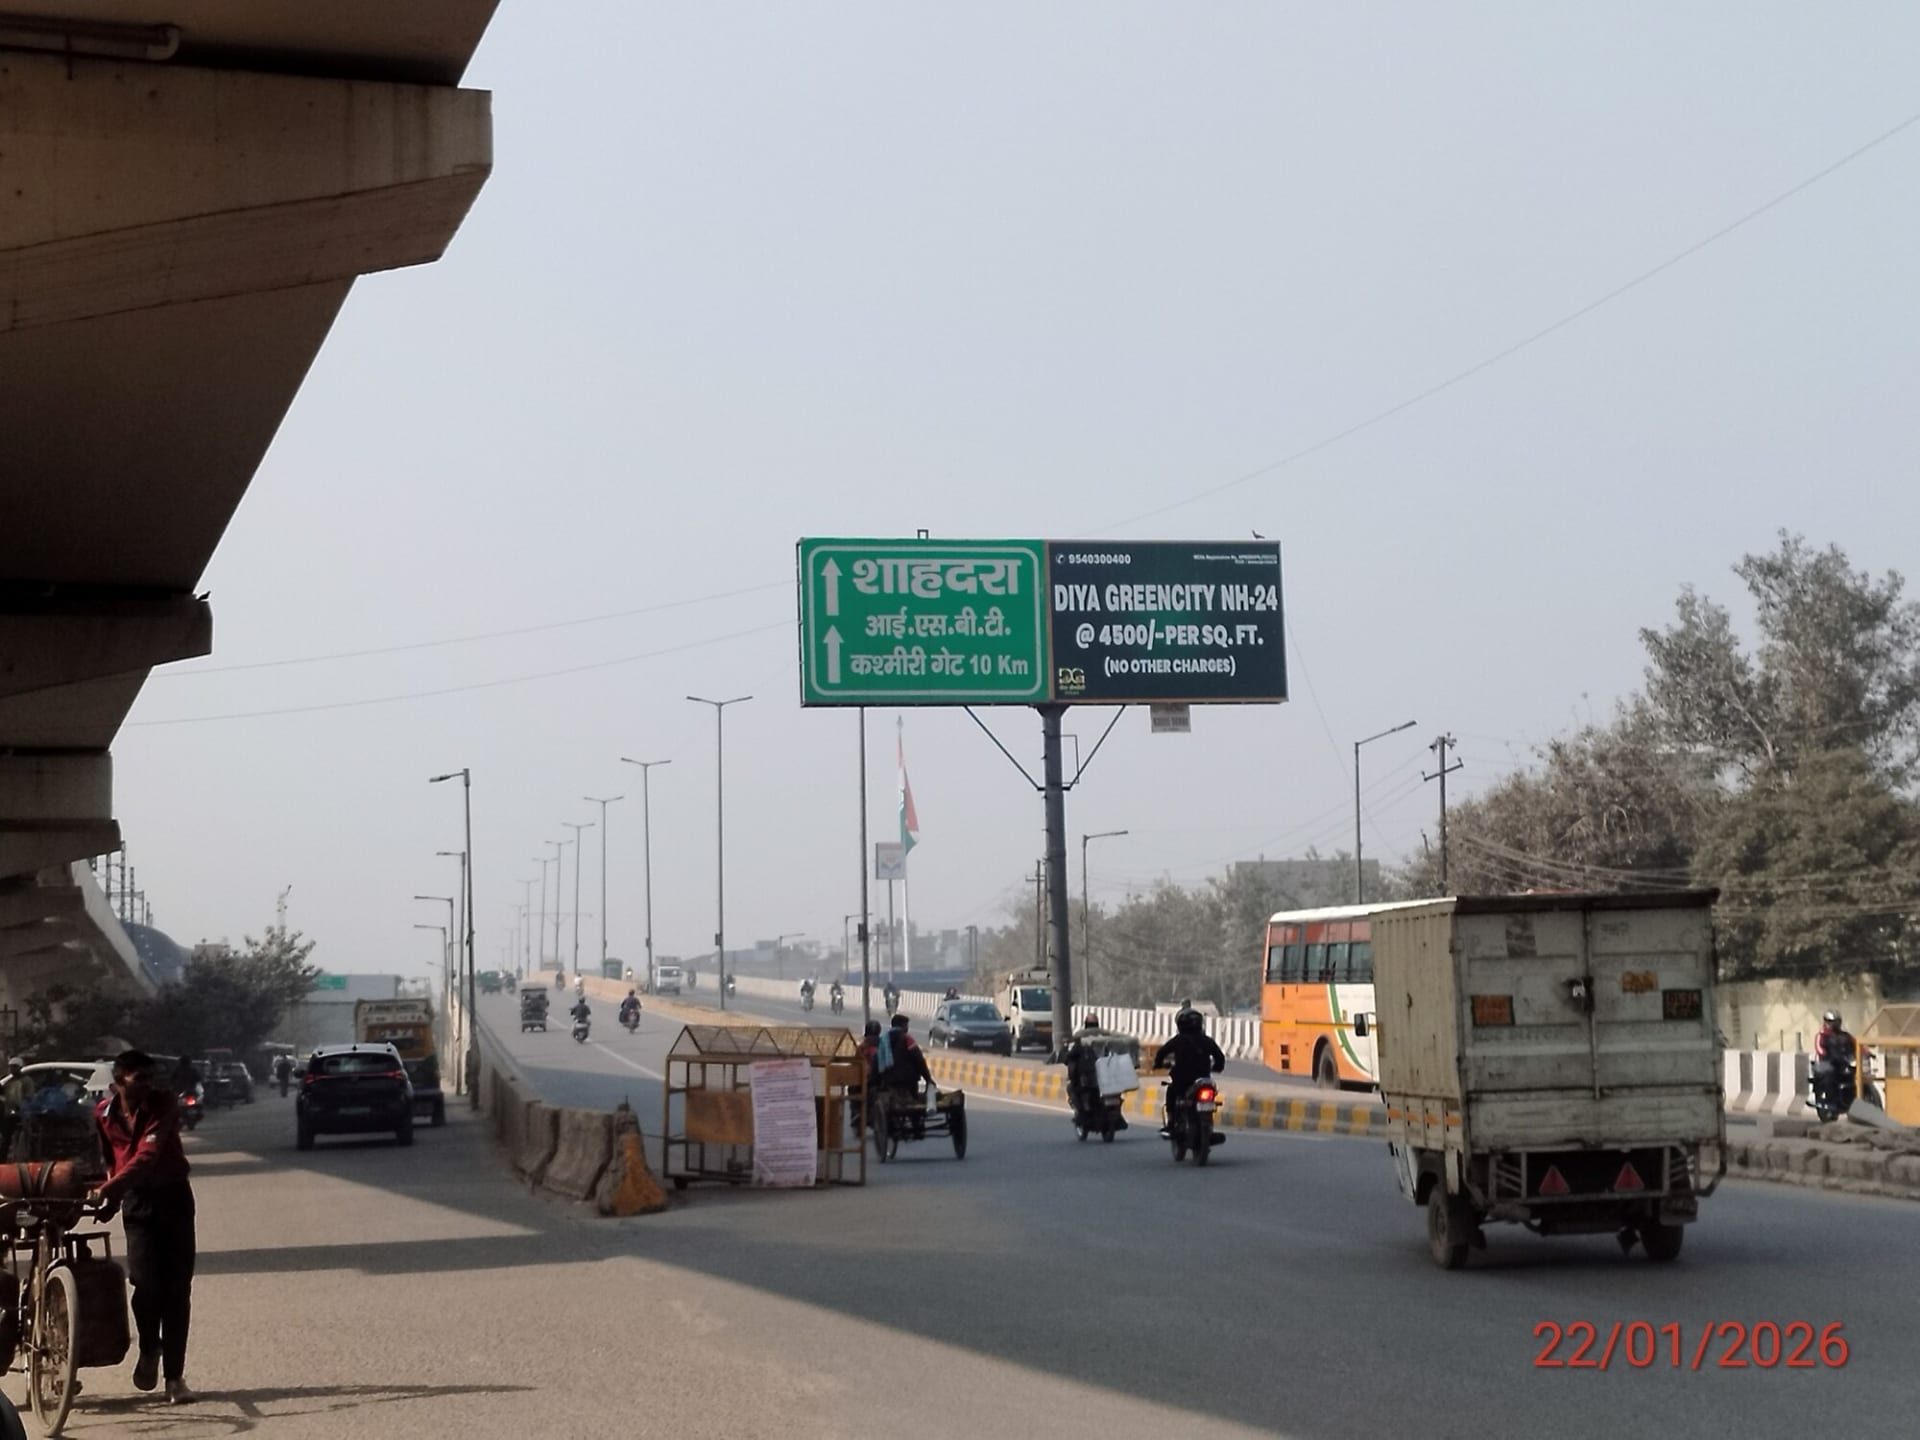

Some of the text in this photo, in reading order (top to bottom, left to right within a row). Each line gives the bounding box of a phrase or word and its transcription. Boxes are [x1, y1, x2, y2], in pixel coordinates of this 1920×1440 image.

[1068, 553, 1131, 565] 9540300400
[852, 557, 1022, 598] शाहदरा
[1054, 584, 1278, 612] DIYA GREENCITY NH-24
[865, 606, 1012, 639] आई.एस.बी.टी.
[1076, 623, 1095, 649] @
[1202, 625, 1234, 648] SQ.
[1236, 625, 1265, 645] FT.
[850, 646, 1029, 676] कश्मीरी गेट 10 Km
[1104, 656, 1236, 677] (NO OTHER CHARGES)
